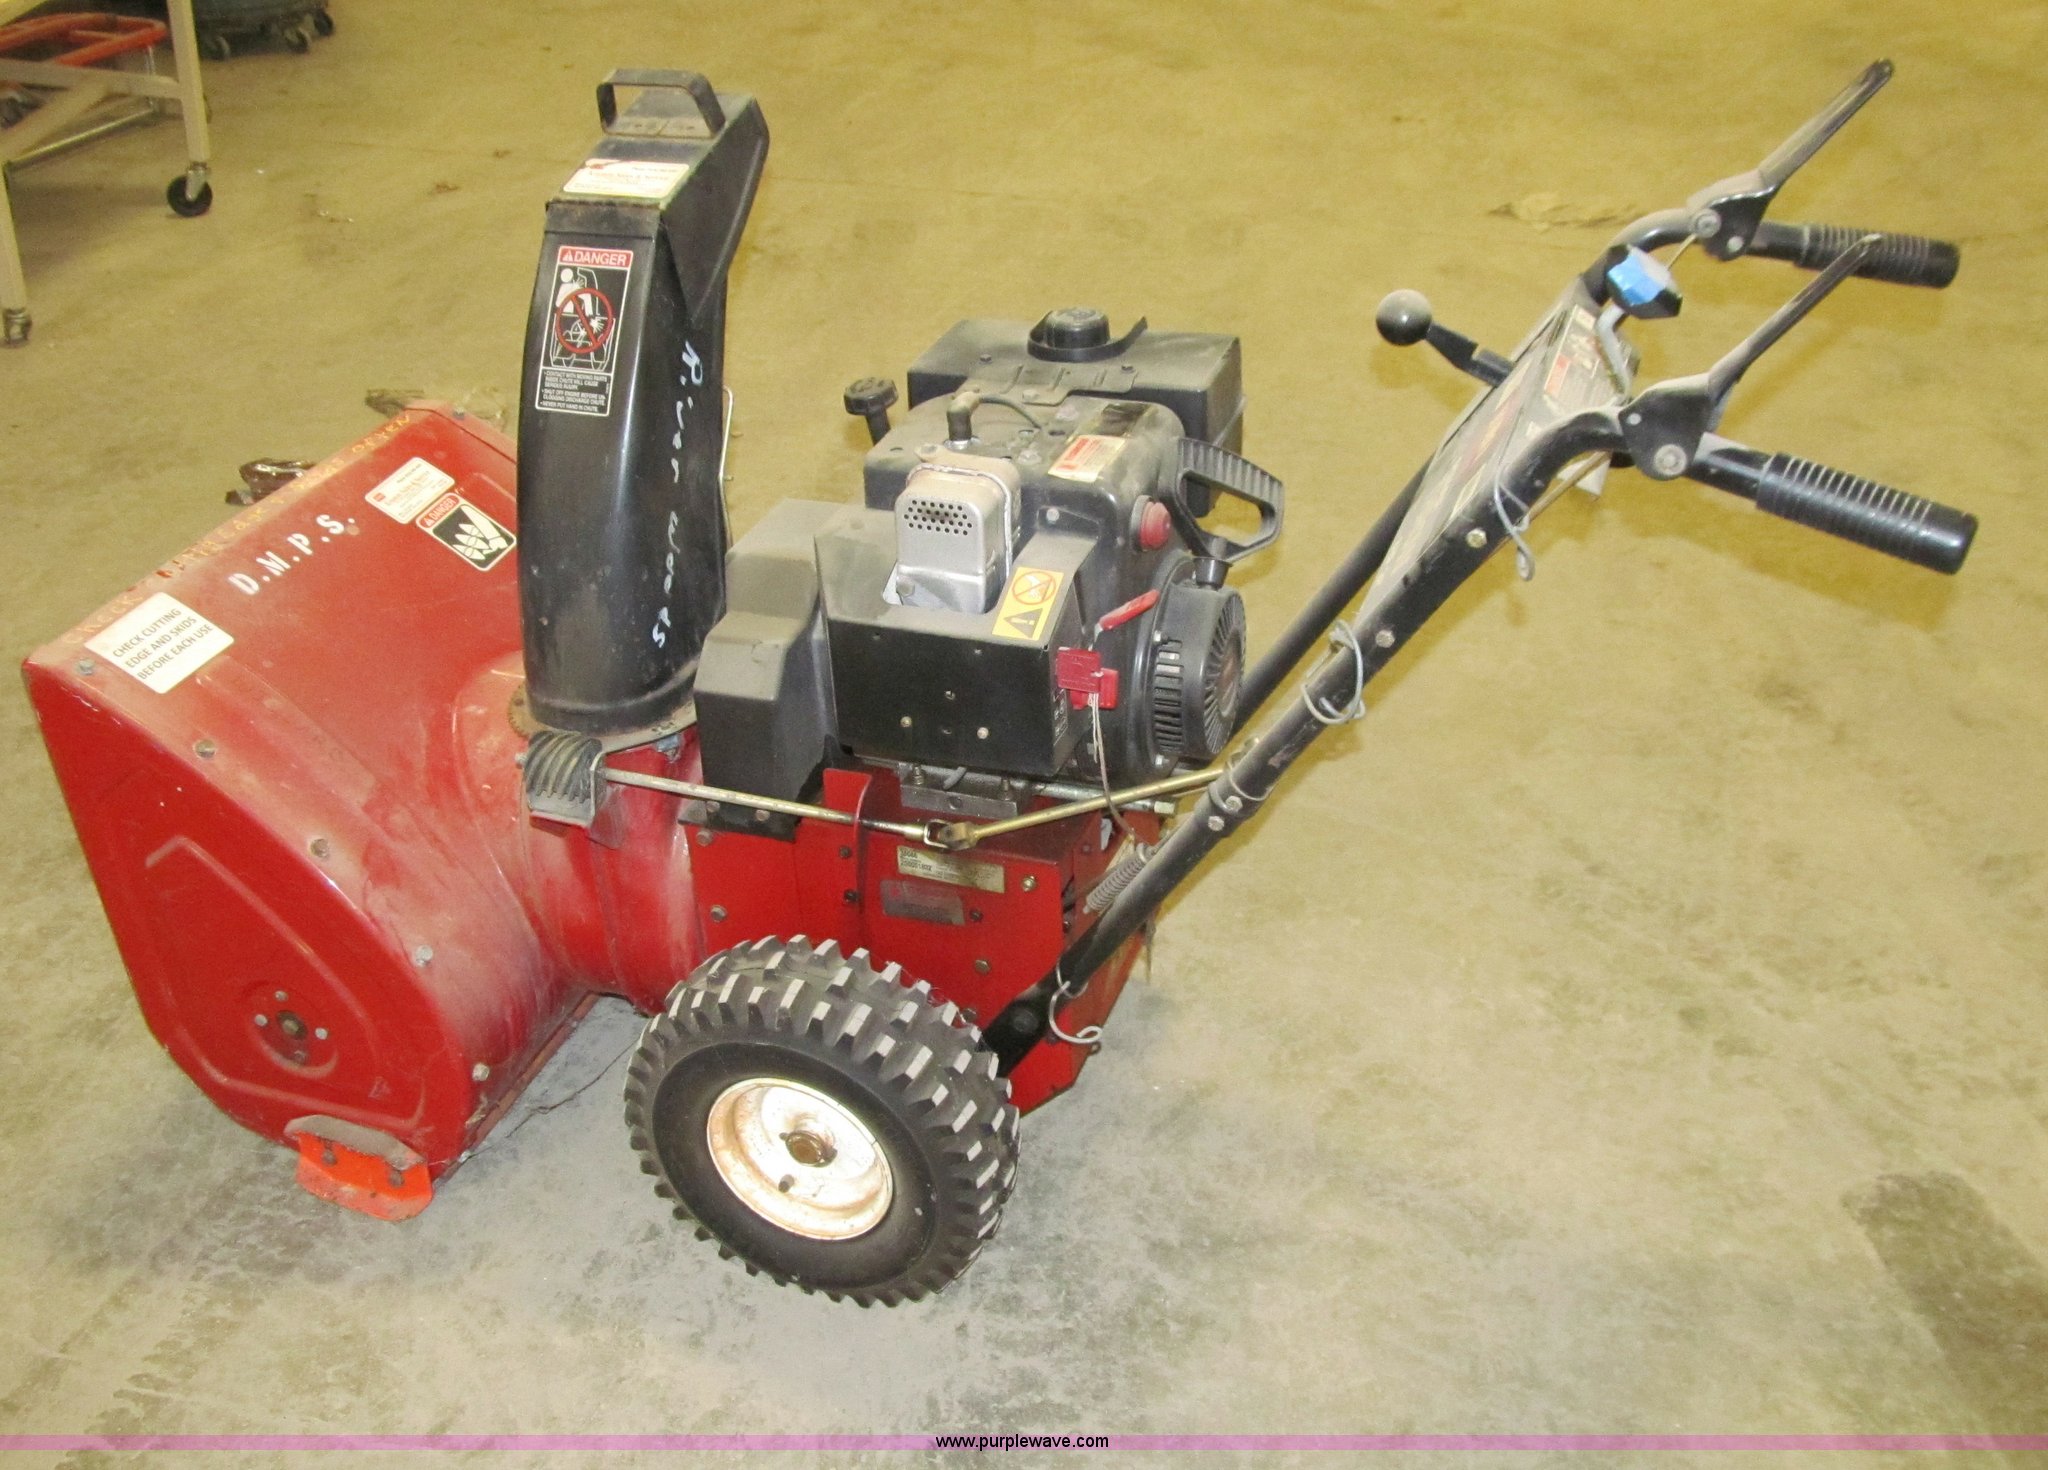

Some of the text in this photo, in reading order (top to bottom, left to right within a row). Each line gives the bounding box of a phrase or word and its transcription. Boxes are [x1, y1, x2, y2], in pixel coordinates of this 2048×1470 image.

[574, 252, 626, 264] DANGER
[428, 498, 456, 520] DANGER
[113, 608, 182, 658] CHECK CUTTING
[125, 616, 197, 668] EDGE AND SKIDS
[137, 624, 213, 680] BEFORE EACH USE
